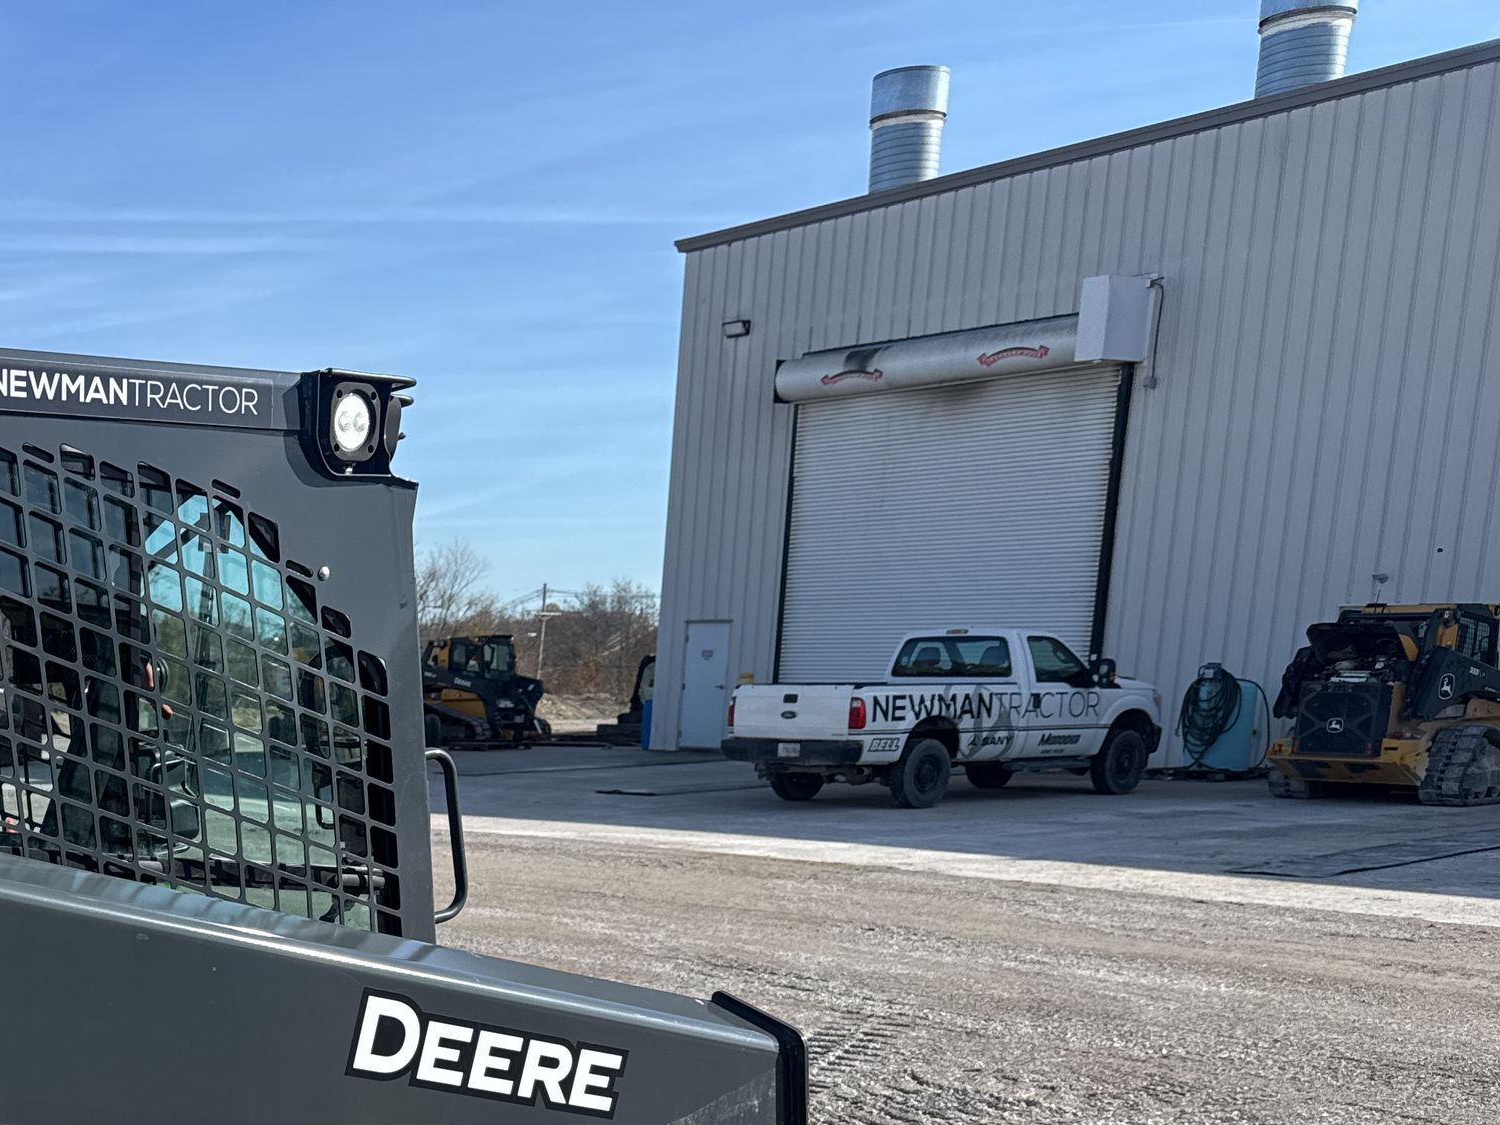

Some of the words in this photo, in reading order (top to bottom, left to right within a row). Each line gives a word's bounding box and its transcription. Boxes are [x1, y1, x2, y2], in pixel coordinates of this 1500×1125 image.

[872, 691, 1101, 722] NEWMANTRACTOR
[869, 738, 899, 751] BELL
[981, 735, 1014, 746] SANY
[352, 994, 623, 1112] DEERE
